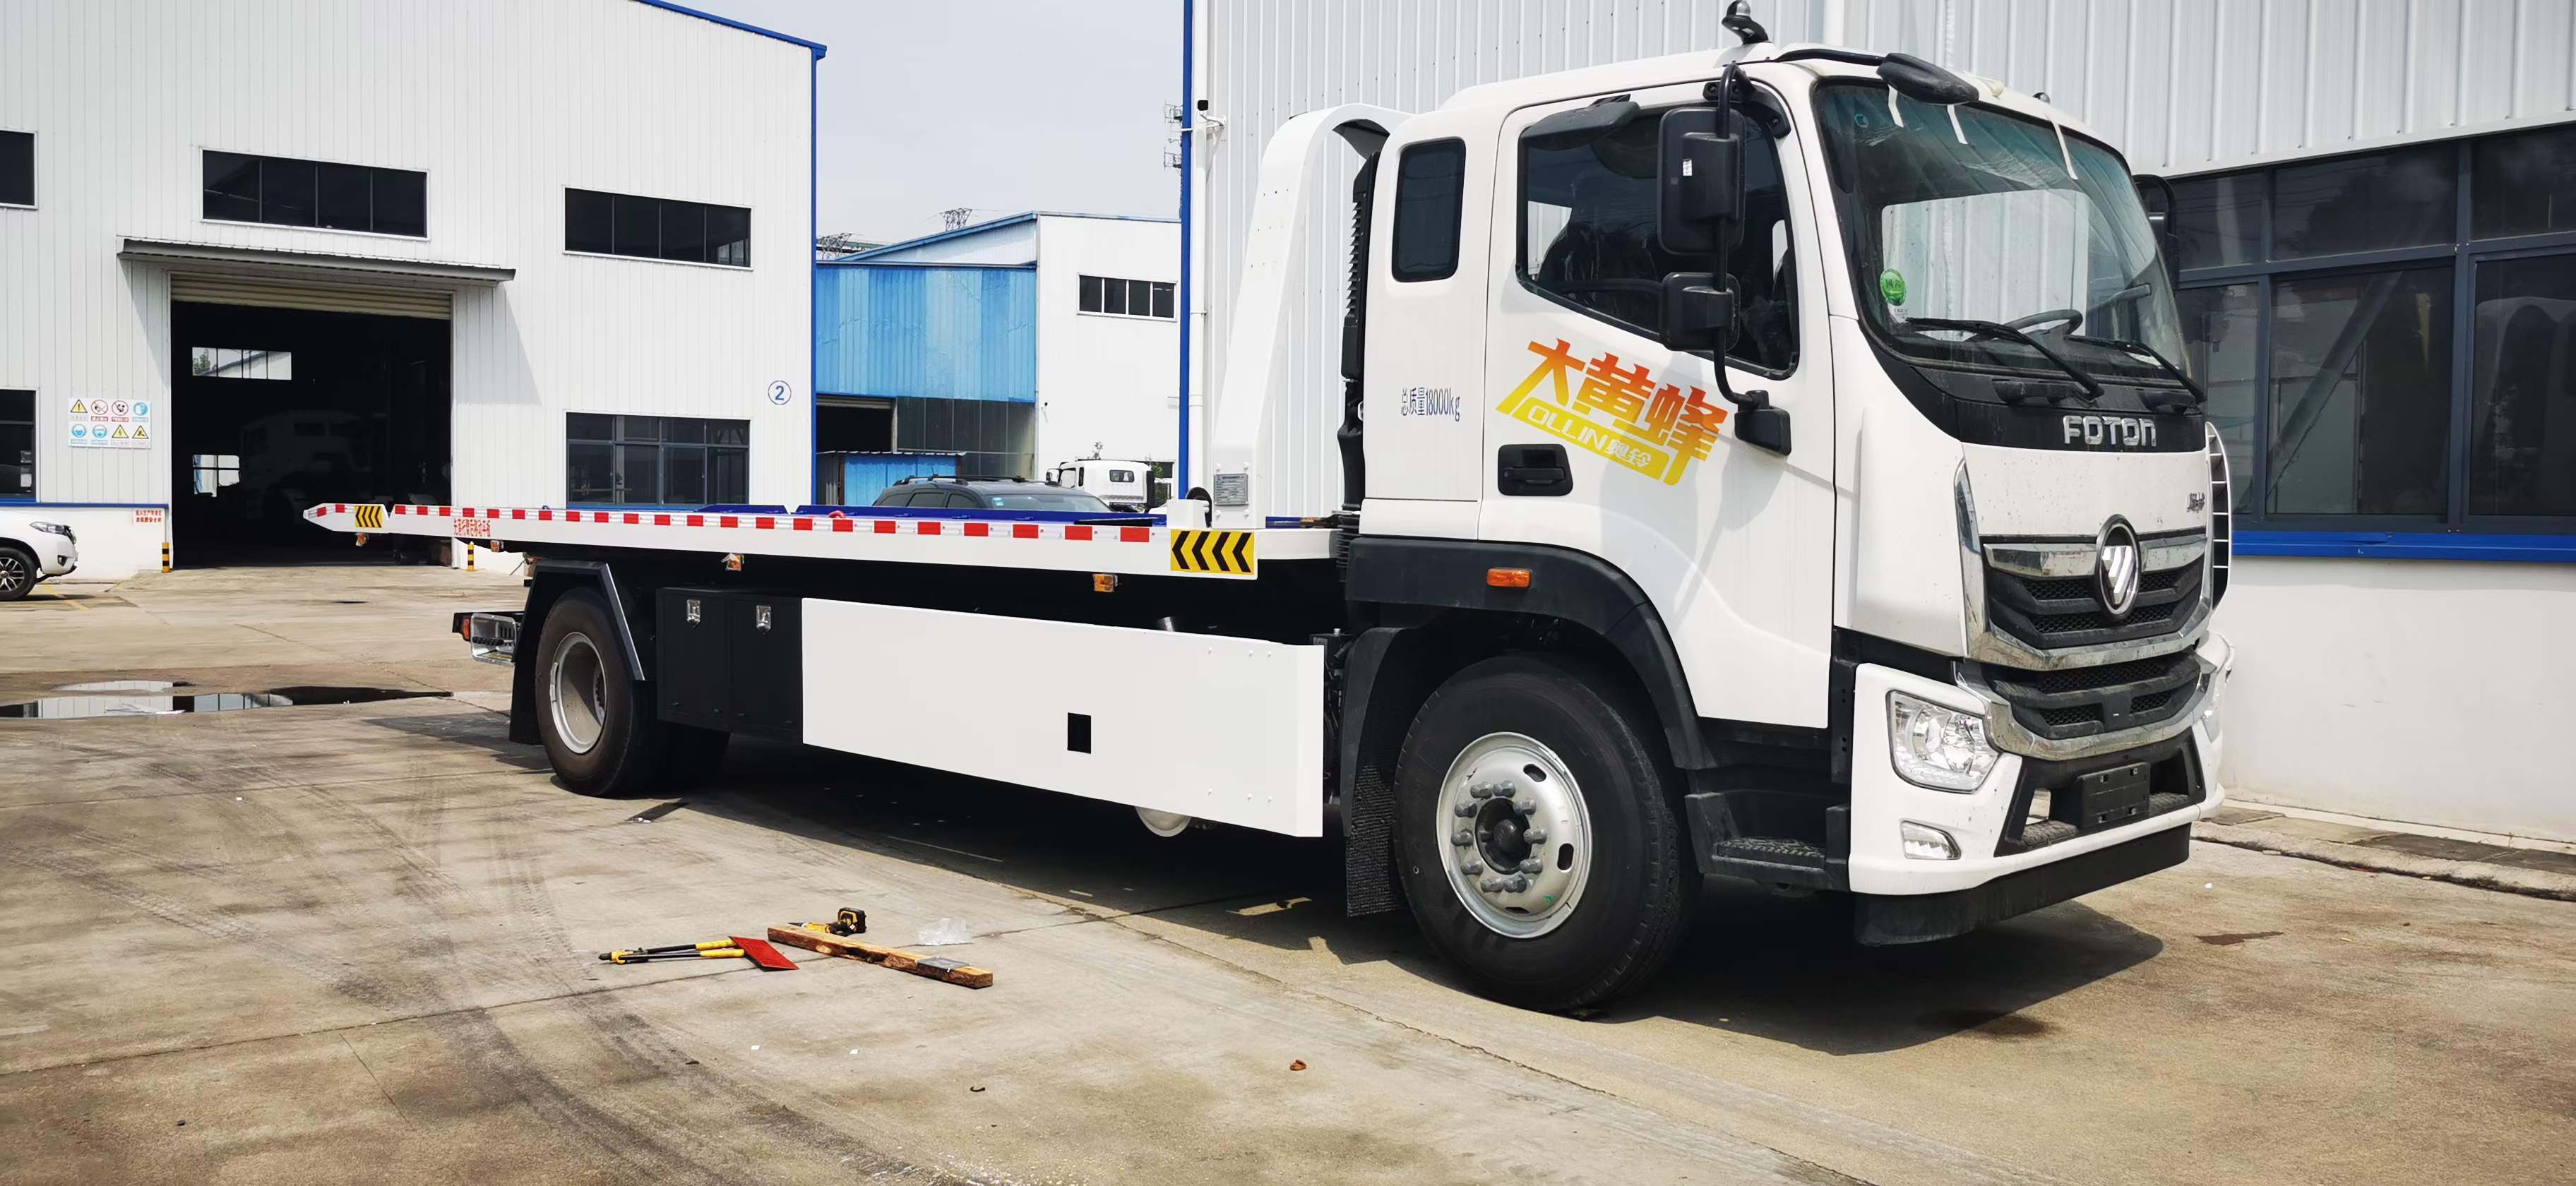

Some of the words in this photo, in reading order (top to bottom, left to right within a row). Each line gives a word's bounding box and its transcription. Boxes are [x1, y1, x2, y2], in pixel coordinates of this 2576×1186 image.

[1496, 338, 1728, 486] 大黄蜂
[2063, 415, 2157, 447] FOTON
